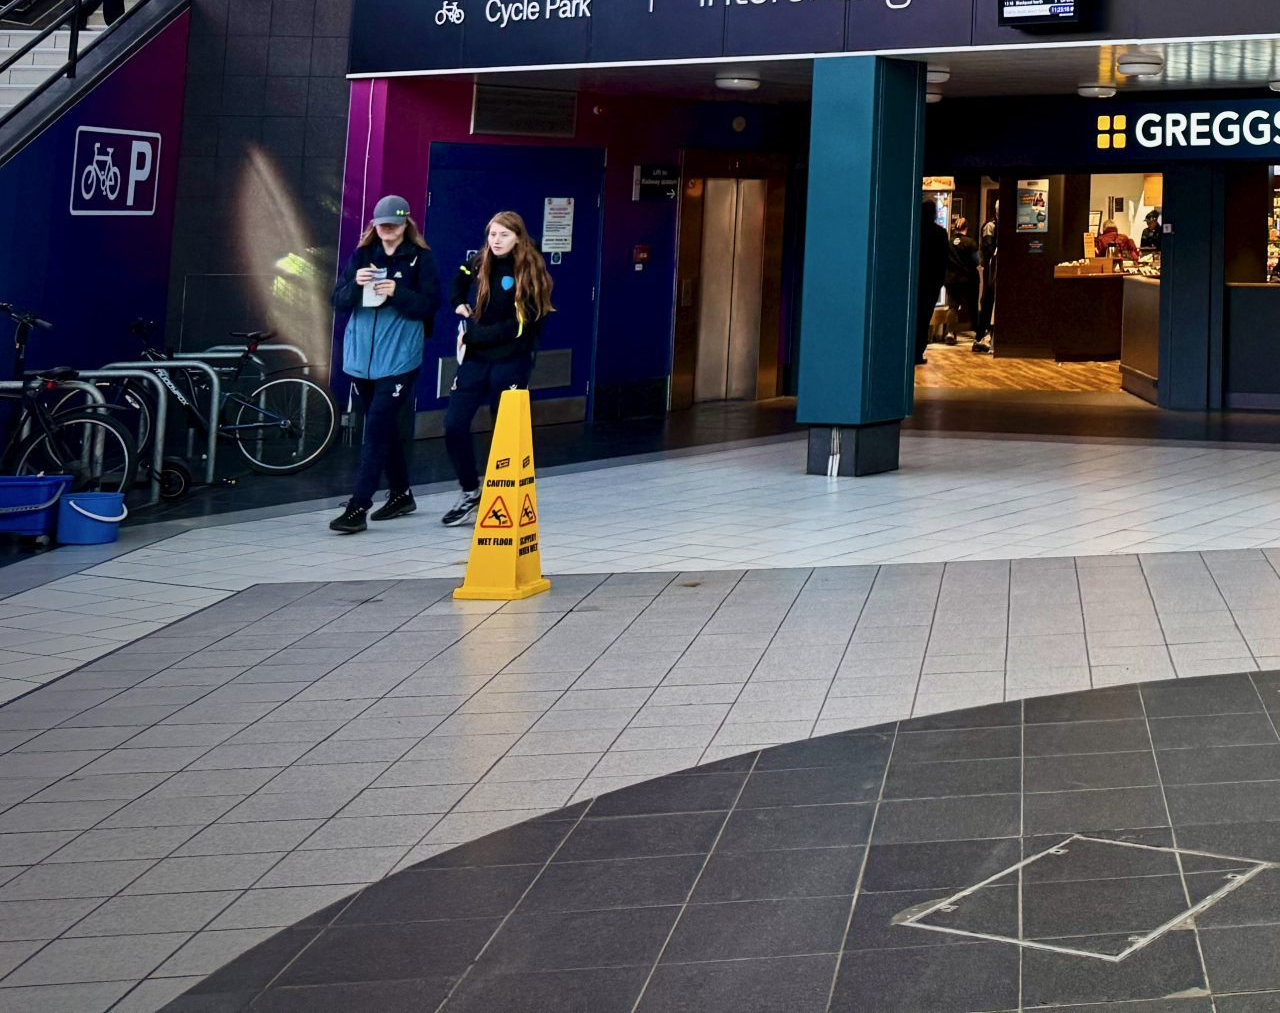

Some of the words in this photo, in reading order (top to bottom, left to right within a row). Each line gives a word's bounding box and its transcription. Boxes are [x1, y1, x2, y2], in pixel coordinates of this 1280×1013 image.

[126, 140, 153, 206] P
[487, 480, 515, 488] CAUTION
[478, 538, 492, 546] WET
[493, 538, 513, 546] FLOOR
